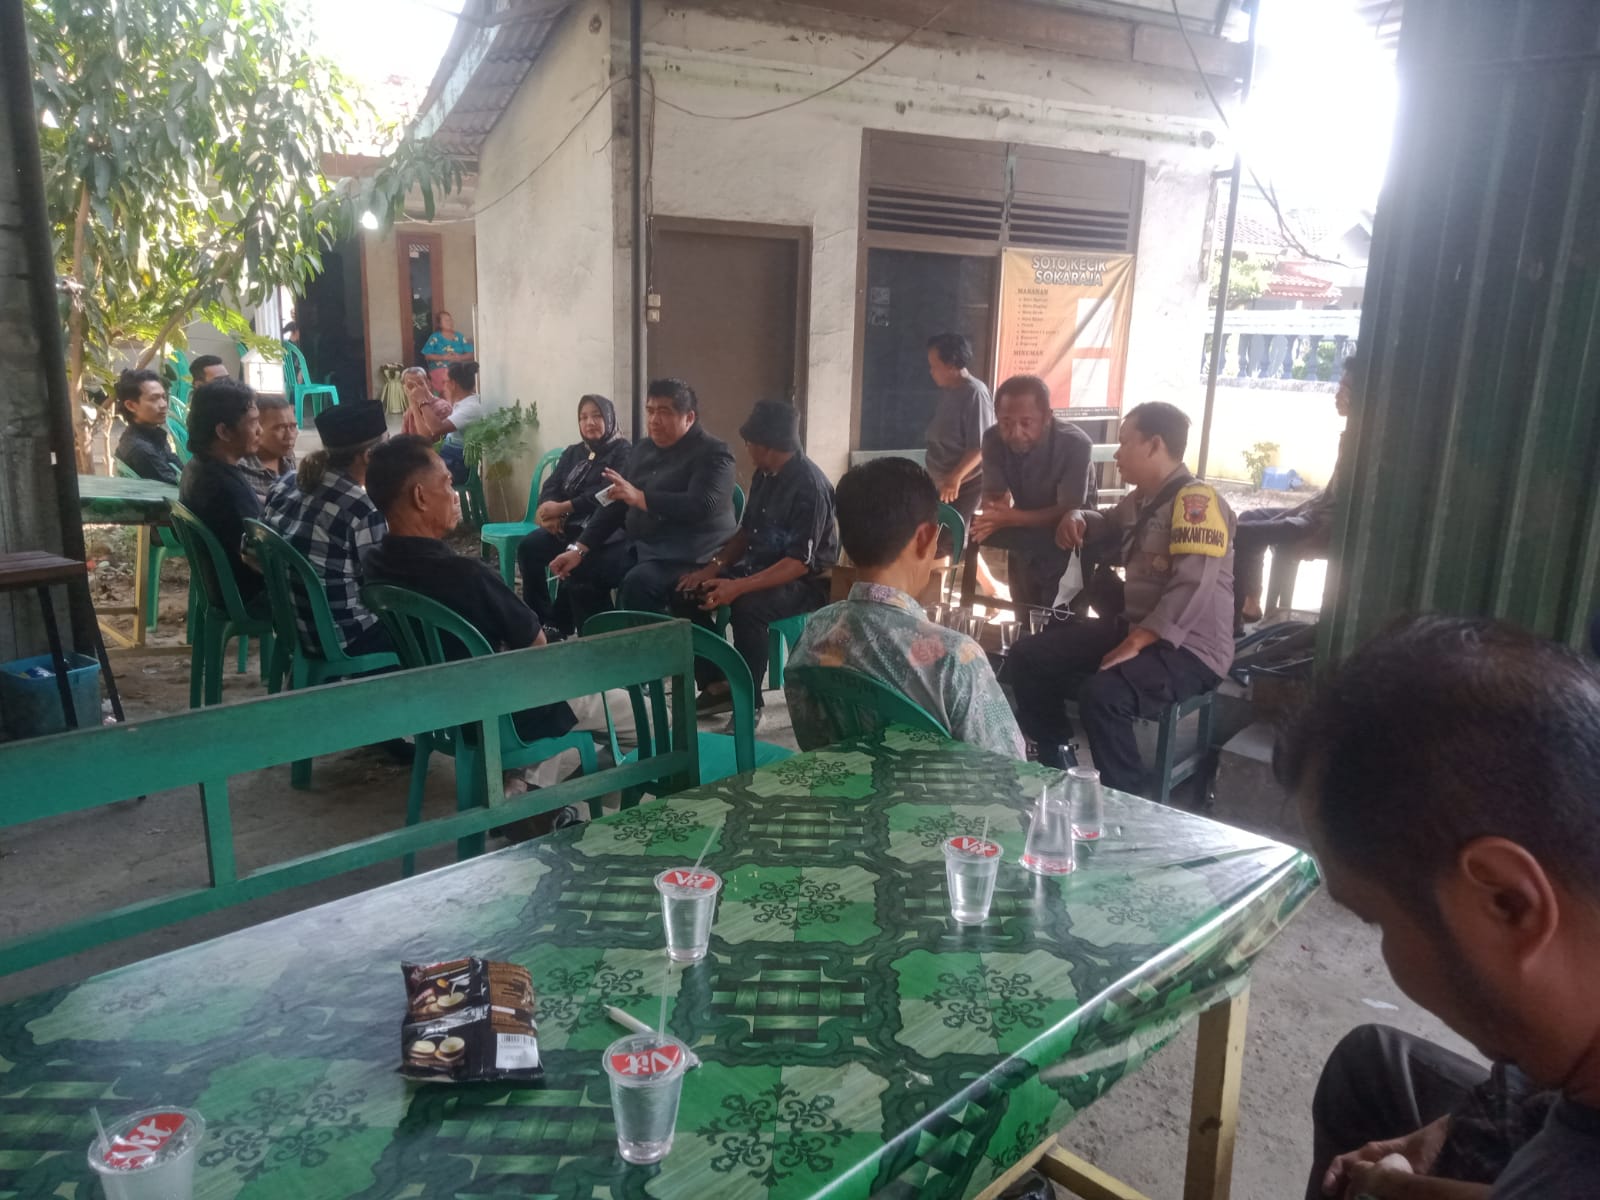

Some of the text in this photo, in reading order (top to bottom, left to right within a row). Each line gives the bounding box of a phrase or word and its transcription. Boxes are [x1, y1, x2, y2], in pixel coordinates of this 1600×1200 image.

[1032, 256, 1106, 272] SOTO KECIK
[1035, 270, 1103, 286] SOKARAJA
[621, 1050, 675, 1074] Vit
